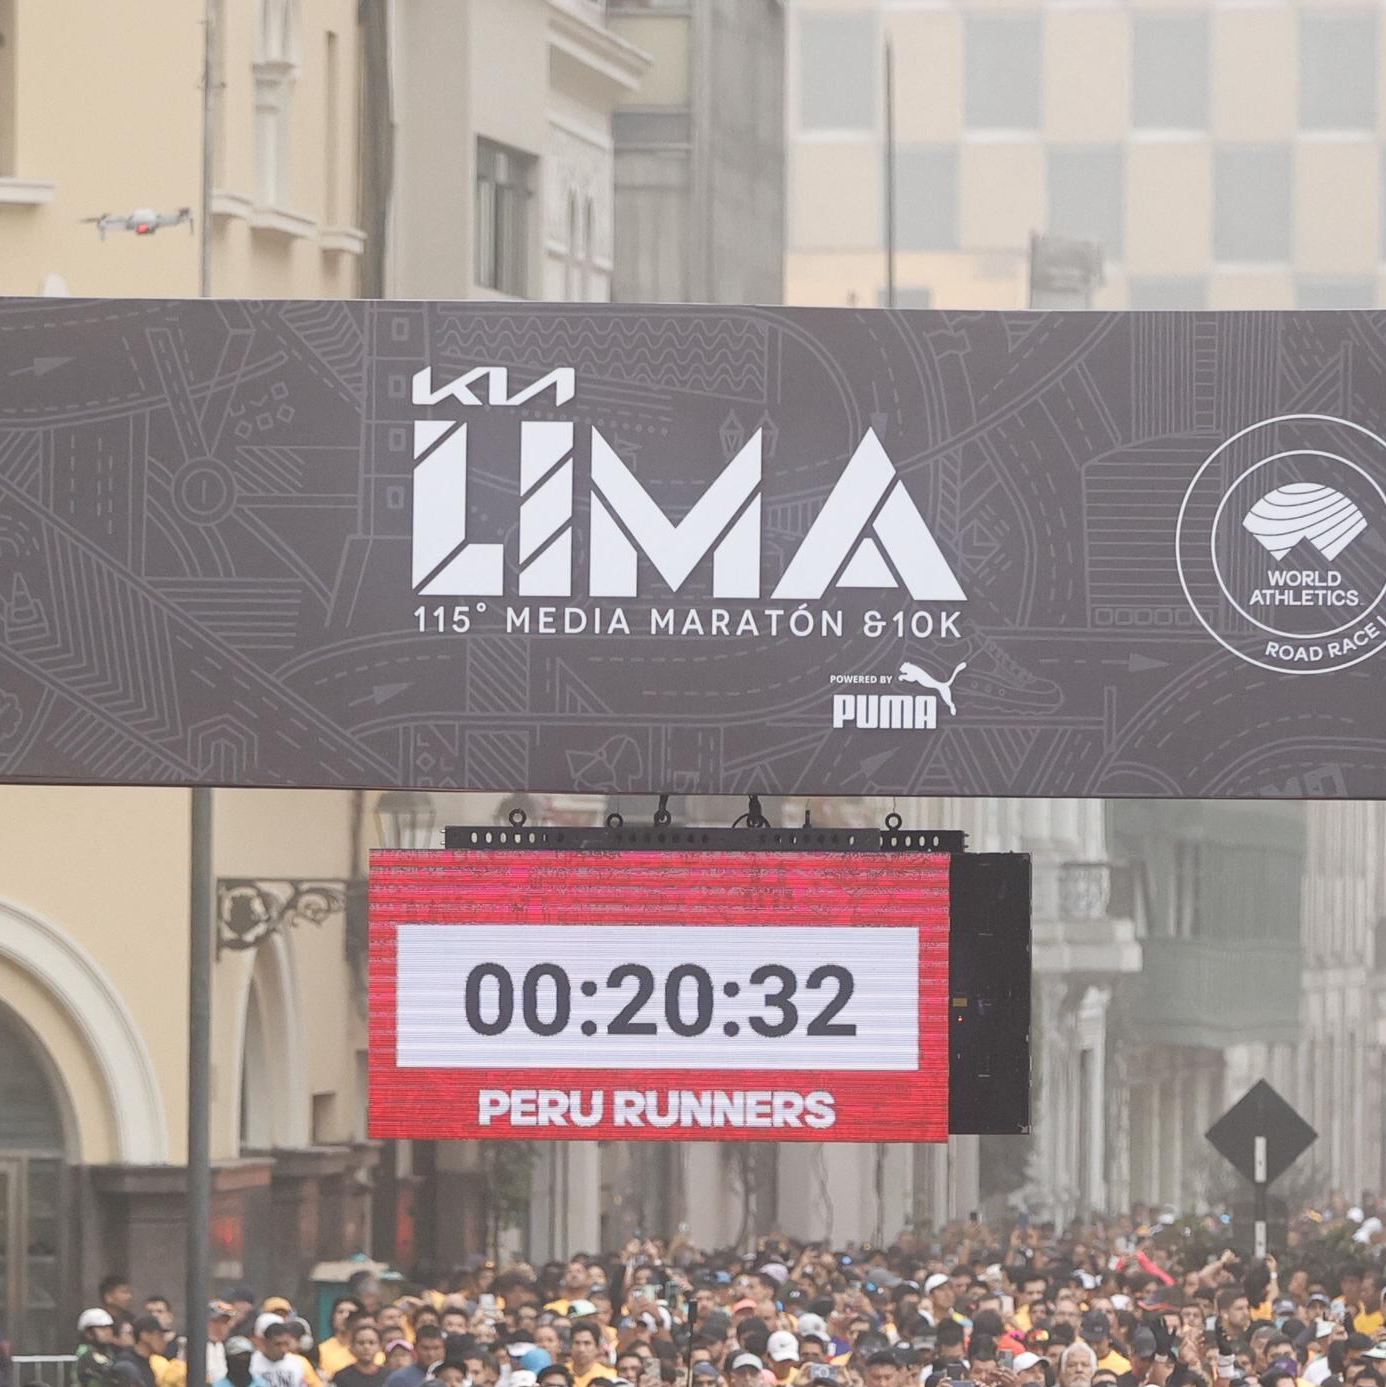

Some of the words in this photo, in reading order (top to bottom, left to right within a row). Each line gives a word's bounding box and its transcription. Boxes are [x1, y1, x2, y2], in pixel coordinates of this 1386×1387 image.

[412, 366, 575, 407] KIA
[412, 420, 968, 601] LIMA
[1249, 589, 1359, 606] ATHLETICS
[1267, 570, 1342, 587] WORLD
[413, 602, 488, 633] 115°
[506, 606, 631, 635] MEDIA
[650, 603, 844, 637] MARATÓN
[863, 610, 962, 638] &10K
[1265, 641, 1323, 662] ROAD
[1327, 622, 1381, 658] RACE
[830, 675, 877, 684] POWERED
[880, 675, 893, 684] BY
[832, 694, 937, 729] PUMA
[464, 961, 857, 1038] 00:20:32
[478, 1088, 605, 1128] PERU
[612, 1089, 836, 1130] RUNNERS
